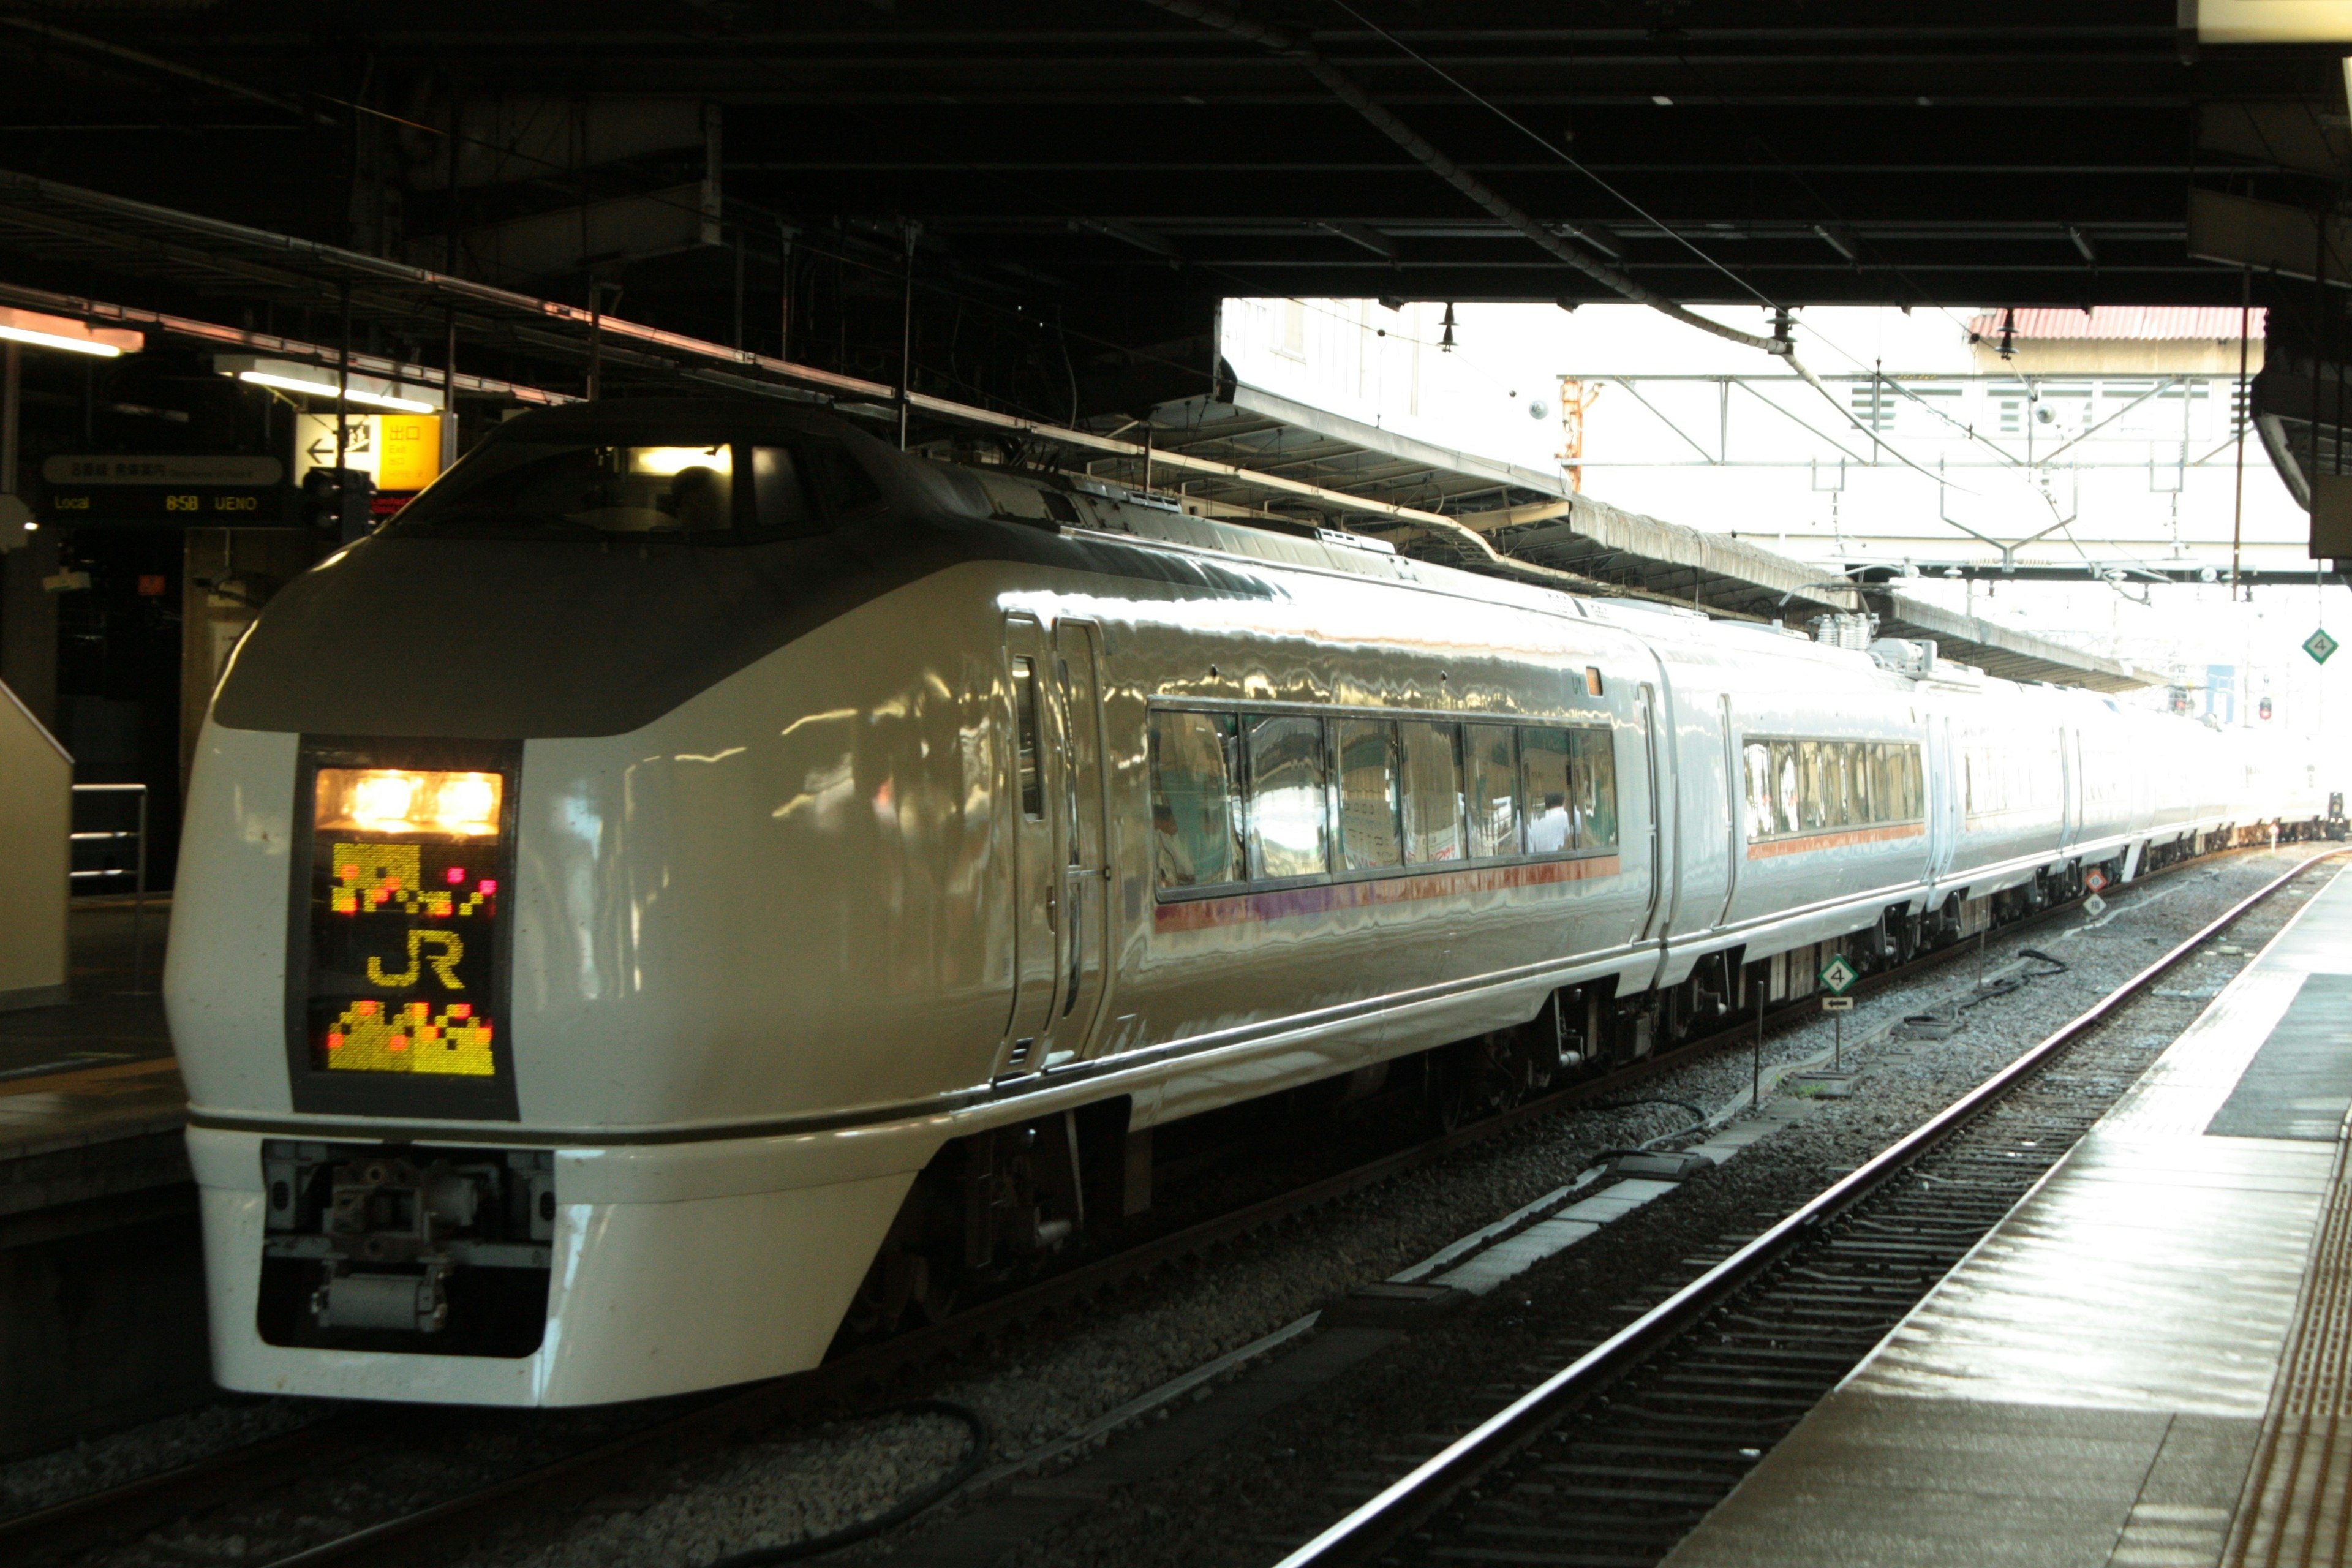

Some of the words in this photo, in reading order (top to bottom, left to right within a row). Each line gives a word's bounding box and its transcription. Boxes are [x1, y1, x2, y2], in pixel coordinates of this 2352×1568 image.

[390, 426, 420, 440] 出口
[55, 496, 89, 509] Local
[215, 496, 258, 510] UENO
[2314, 639, 2327, 651] 4
[367, 929, 466, 989] JR
[1830, 968, 1845, 983] 4
